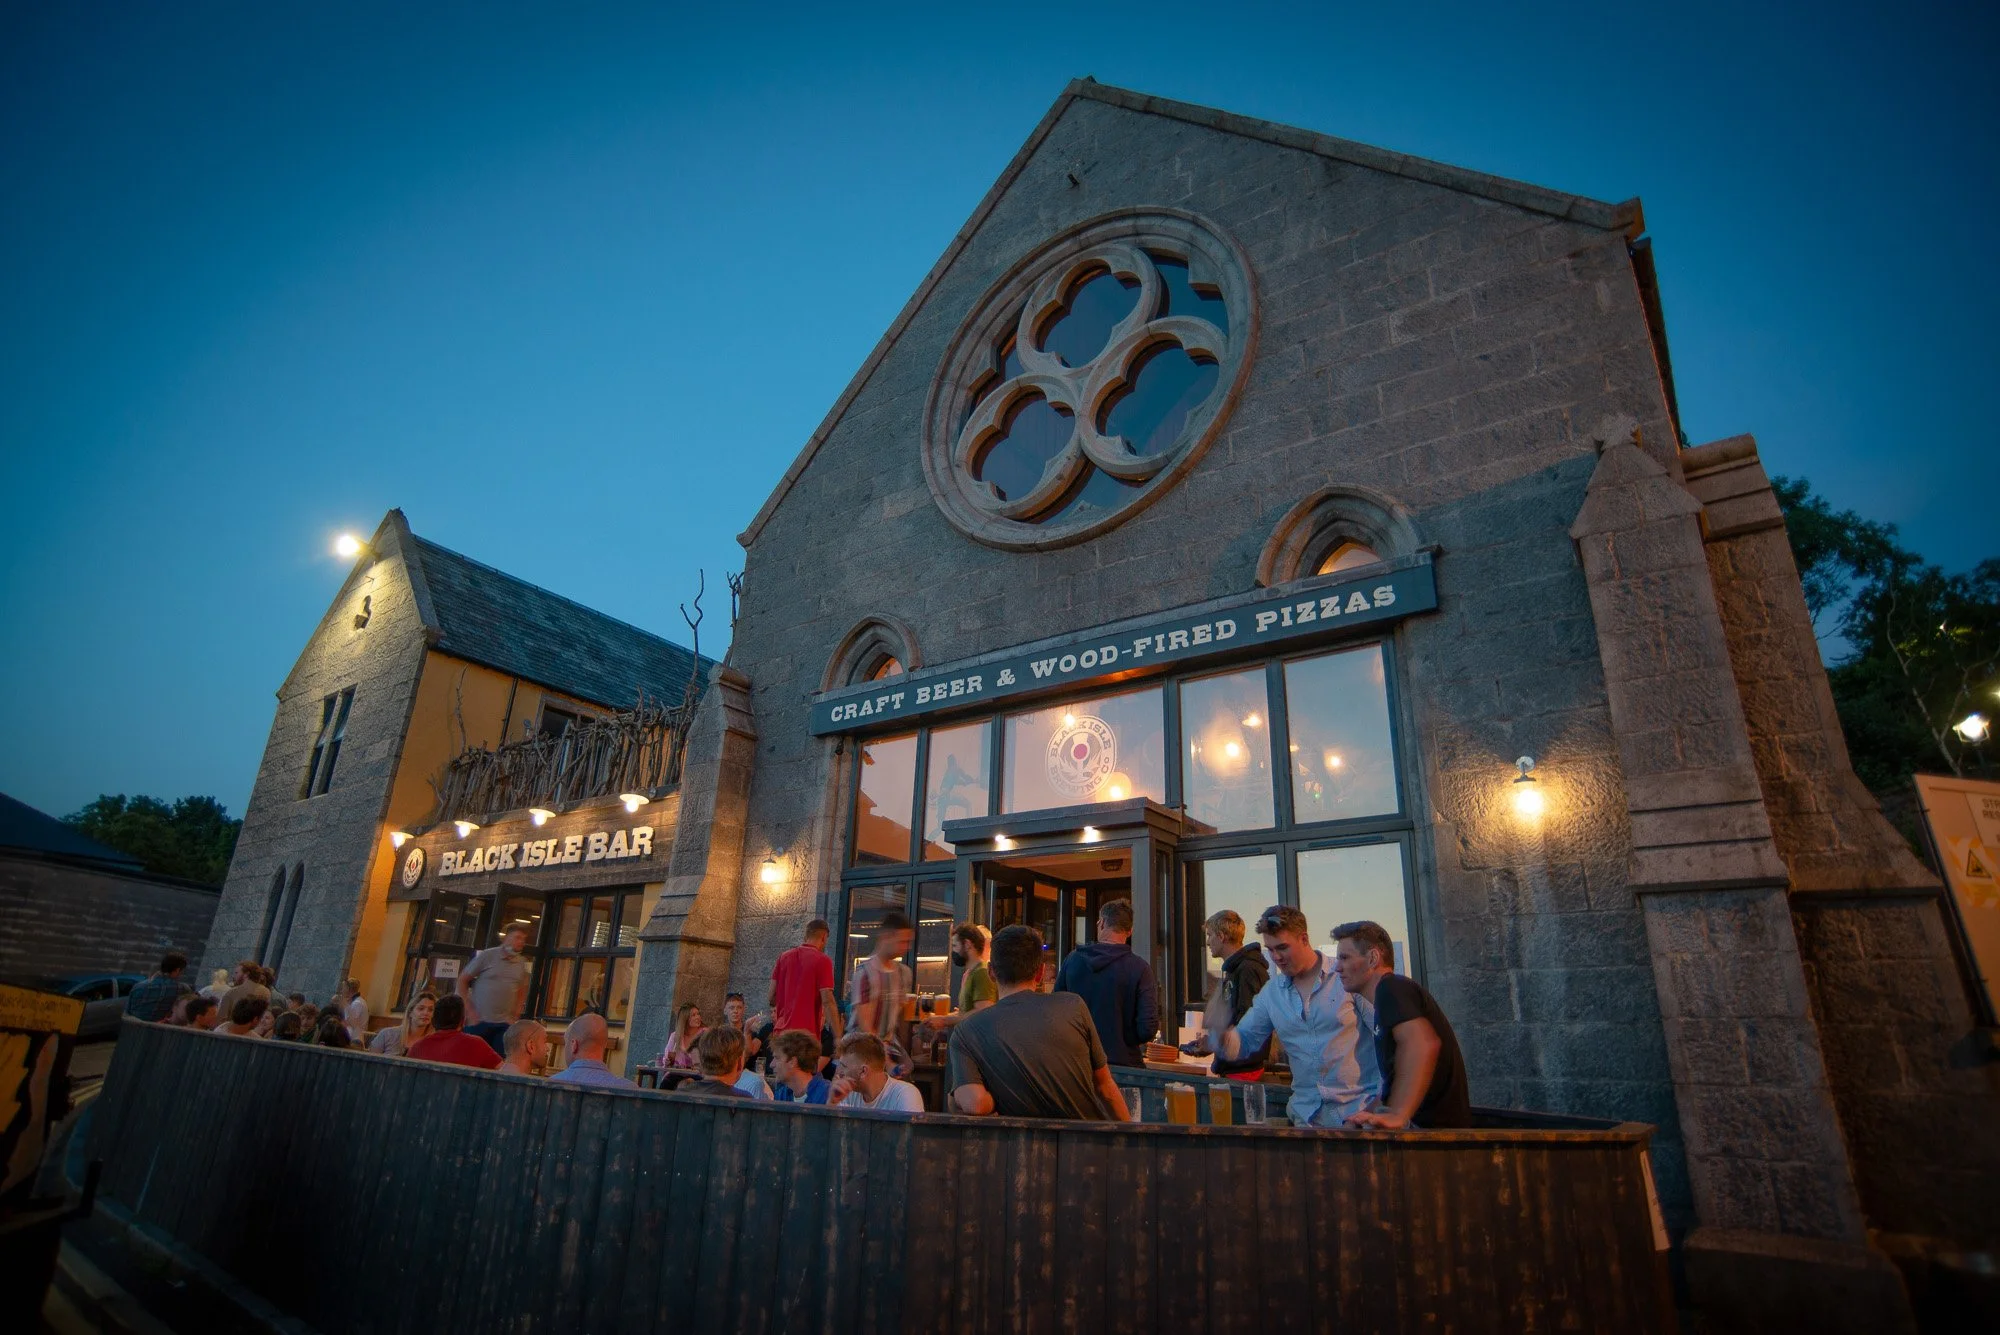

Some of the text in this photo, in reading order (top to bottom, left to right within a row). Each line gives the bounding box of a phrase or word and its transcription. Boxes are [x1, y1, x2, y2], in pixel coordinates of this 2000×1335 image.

[831, 585, 1396, 722] CRAFT BEER & WOOD-FIRED PIZZAS
[1087, 721, 1112, 750] ISLE
[438, 843, 518, 876] BLACK
[519, 834, 583, 868] ISLE
[584, 826, 655, 862] BAR
